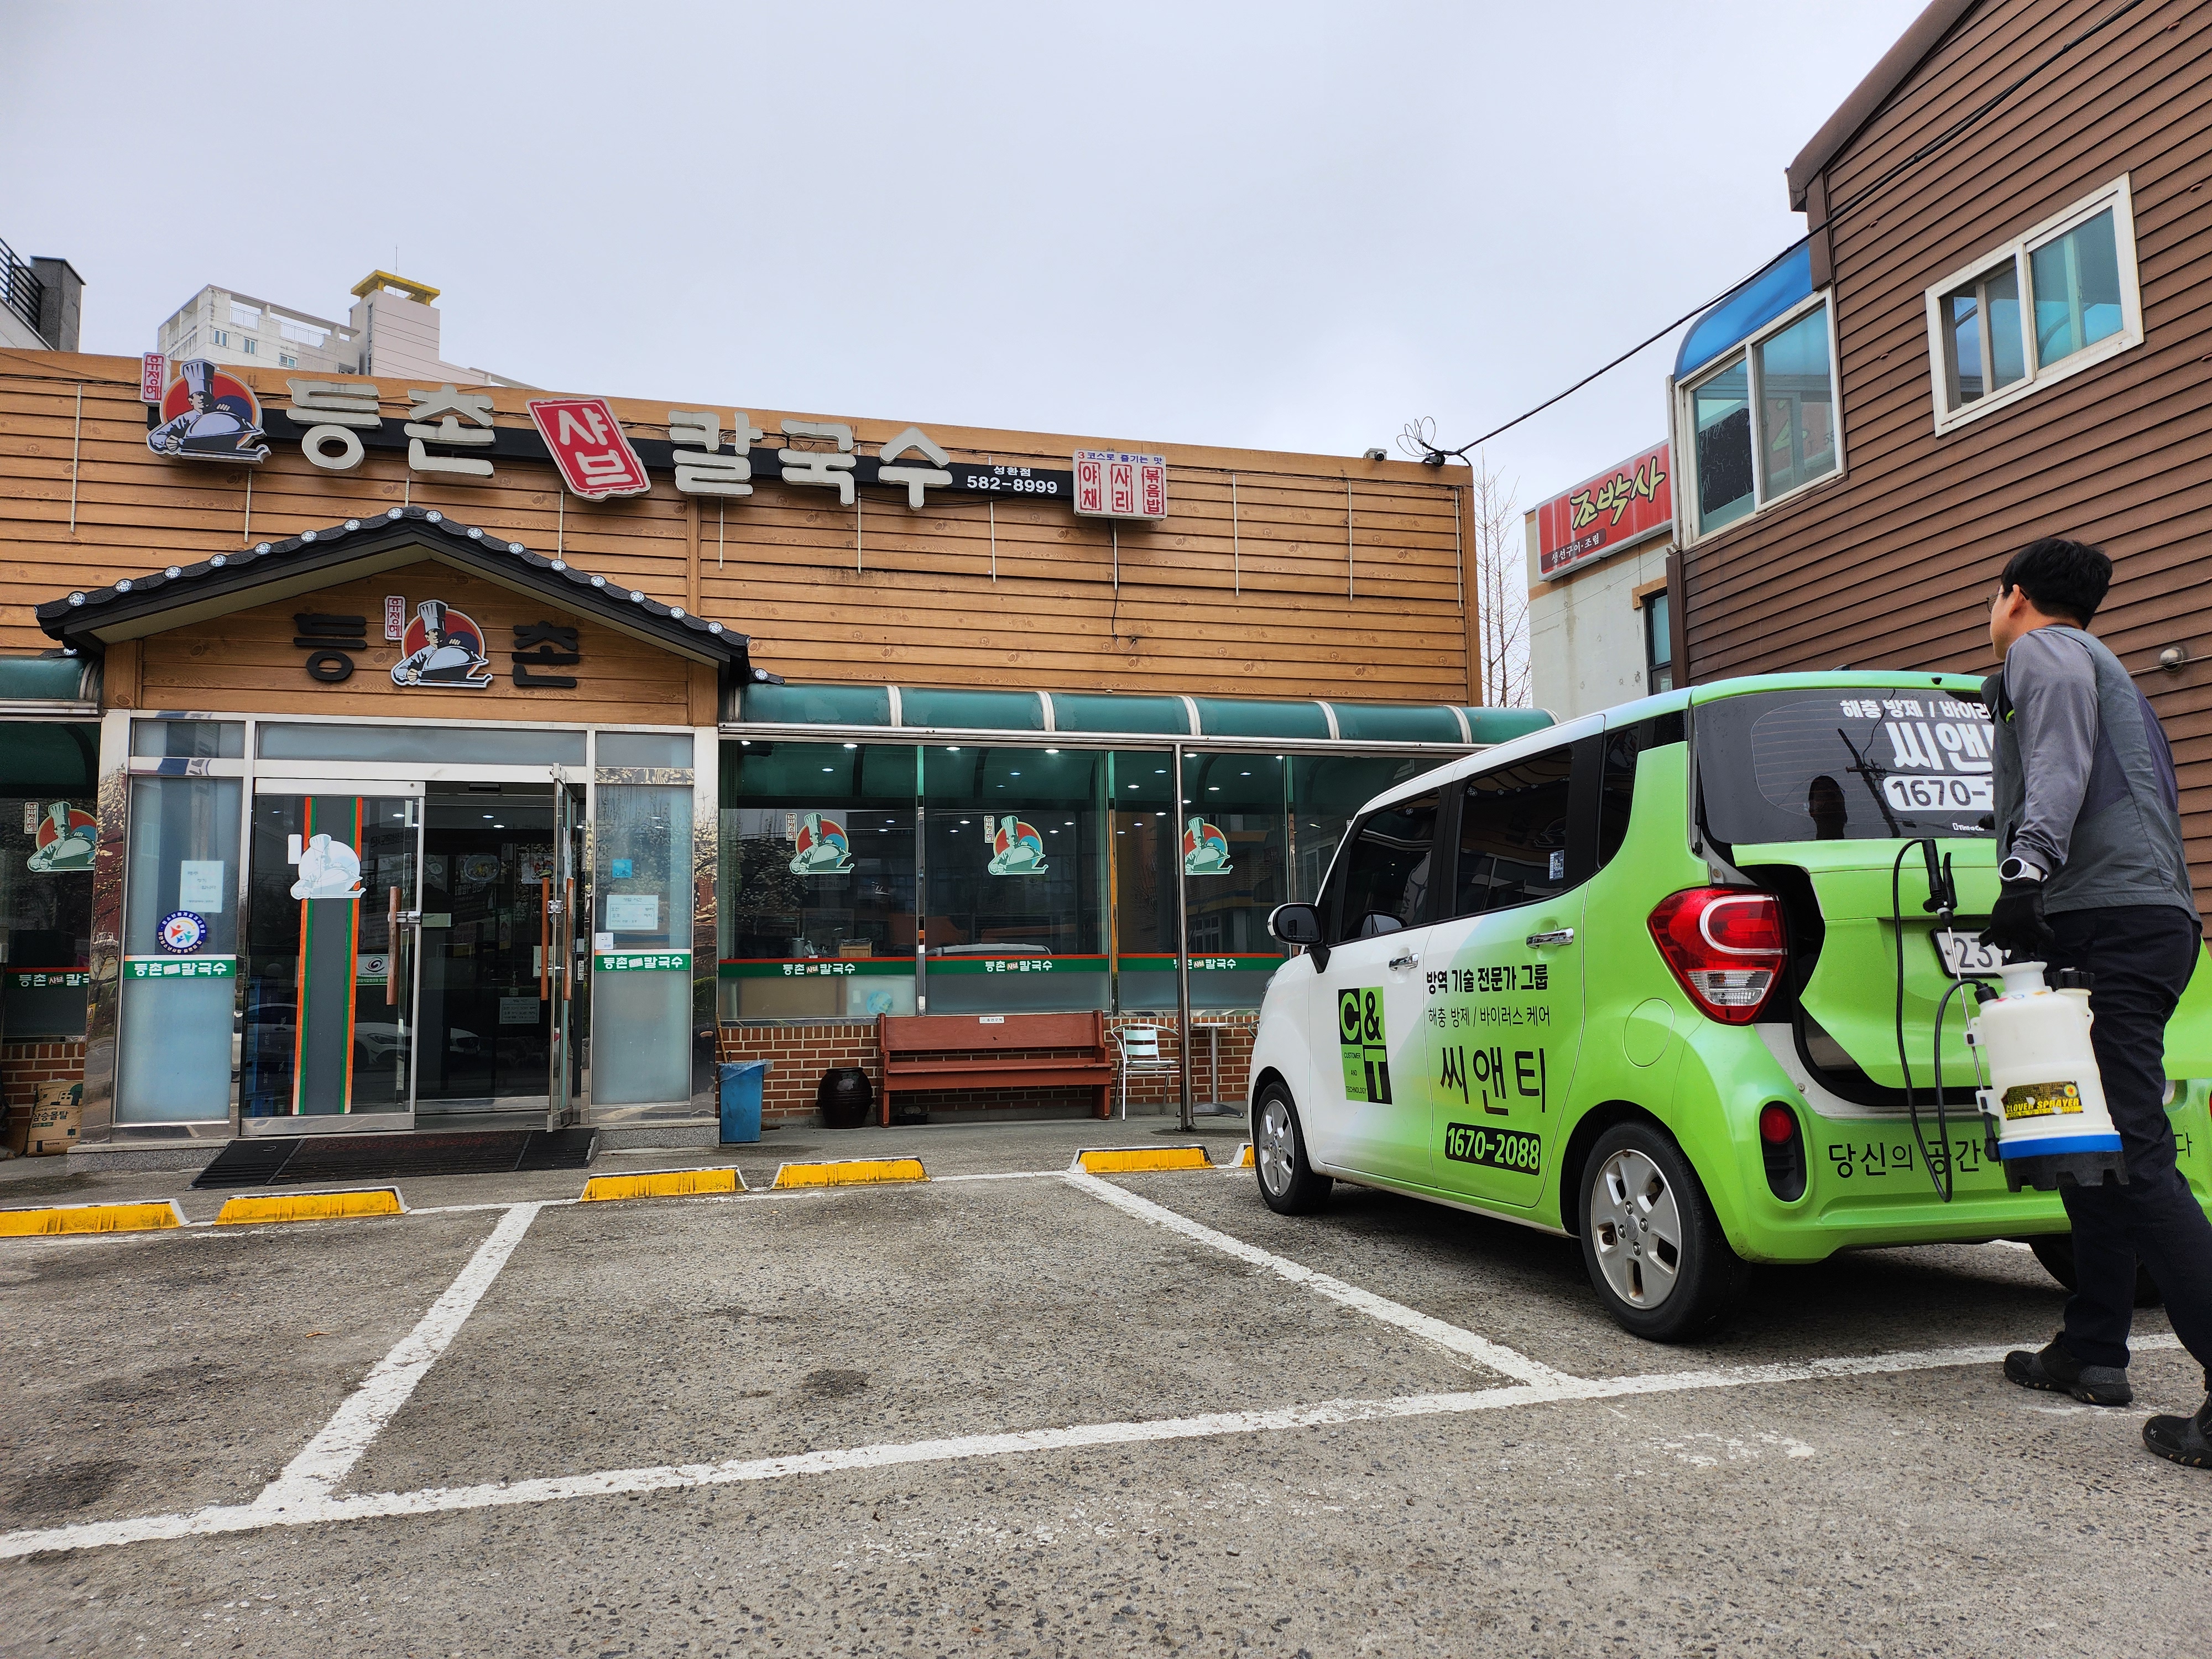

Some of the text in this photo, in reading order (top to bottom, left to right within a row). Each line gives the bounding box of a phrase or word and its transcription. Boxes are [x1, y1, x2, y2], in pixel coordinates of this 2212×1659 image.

[286, 378, 495, 479] 등촌
[669, 409, 953, 511] 칼국수
[1120, 454, 1149, 464] 즐기는
[1154, 456, 1162, 465] 맛
[993, 466, 1031, 477] 성환점
[967, 476, 1057, 494] 582-8999
[1082, 465, 1098, 509] 야채
[1114, 469, 1130, 511] 사리
[1145, 469, 1162, 512] 볶음밥
[1571, 456, 1666, 530] 조박사
[1840, 700, 1882, 718] 해충
[1882, 700, 1924, 718] 방제
[1885, 722, 1995, 771] 씨앤
[1891, 780, 1993, 806] 1670-
[134, 963, 162, 977] 등촌
[181, 962, 227, 975] 칼국수
[603, 957, 628, 969] 등촌
[644, 956, 683, 968] 칼국수
[782, 964, 805, 975] 등촌
[820, 963, 855, 974] 칼국수
[985, 961, 1005, 972] 등촌
[1019, 961, 1053, 971] 칼국수
[1205, 958, 1237, 969] 칼국수
[19, 974, 46, 987] 등촌
[1426, 964, 1548, 995] 방역 기술 전문가 그룹
[1428, 1005, 1550, 1028] 해충 방제 / 바이러스 케어
[1346, 1086, 1367, 1094] TECHNOLOGY
[1440, 1046, 1546, 1116] 씨앤티
[2037, 1098, 2079, 1109] SPRAYER
[1448, 1128, 1540, 1170] 1670-2088
[1829, 1142, 1913, 1178] 당신의
[1928, 1139, 2001, 1175] 공간
